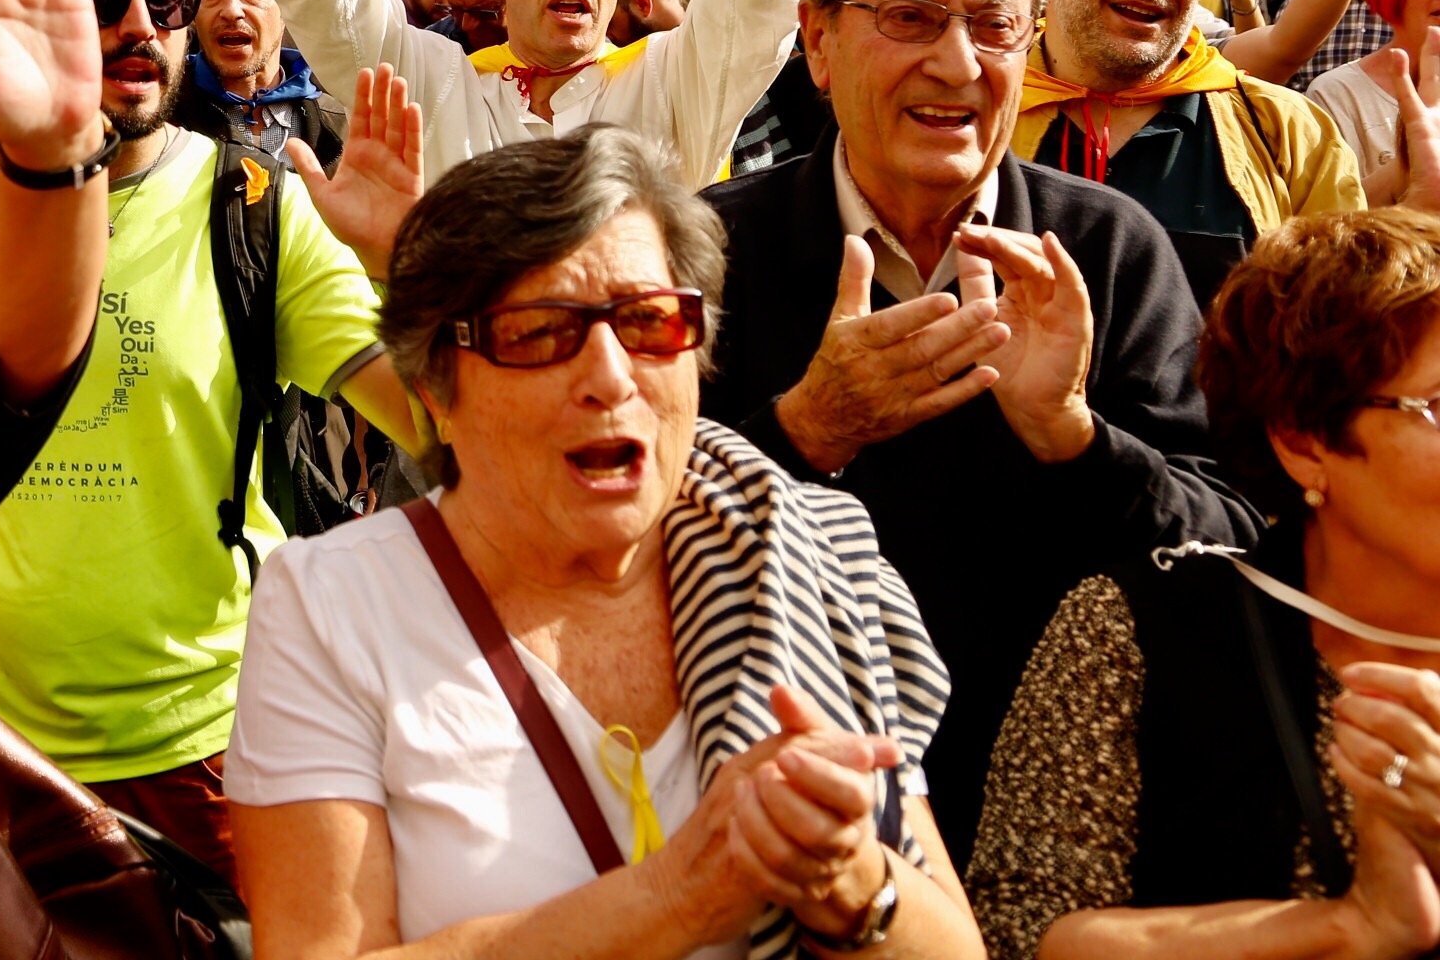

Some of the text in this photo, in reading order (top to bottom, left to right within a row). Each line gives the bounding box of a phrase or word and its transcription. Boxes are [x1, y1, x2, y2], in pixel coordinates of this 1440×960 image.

[101, 291, 129, 315] Sí
[114, 316, 156, 336] Yes
[120, 337, 154, 353] Oui
[120, 353, 138, 365] Da
[112, 388, 129, 406] 是
[112, 406, 128, 414] Sim
